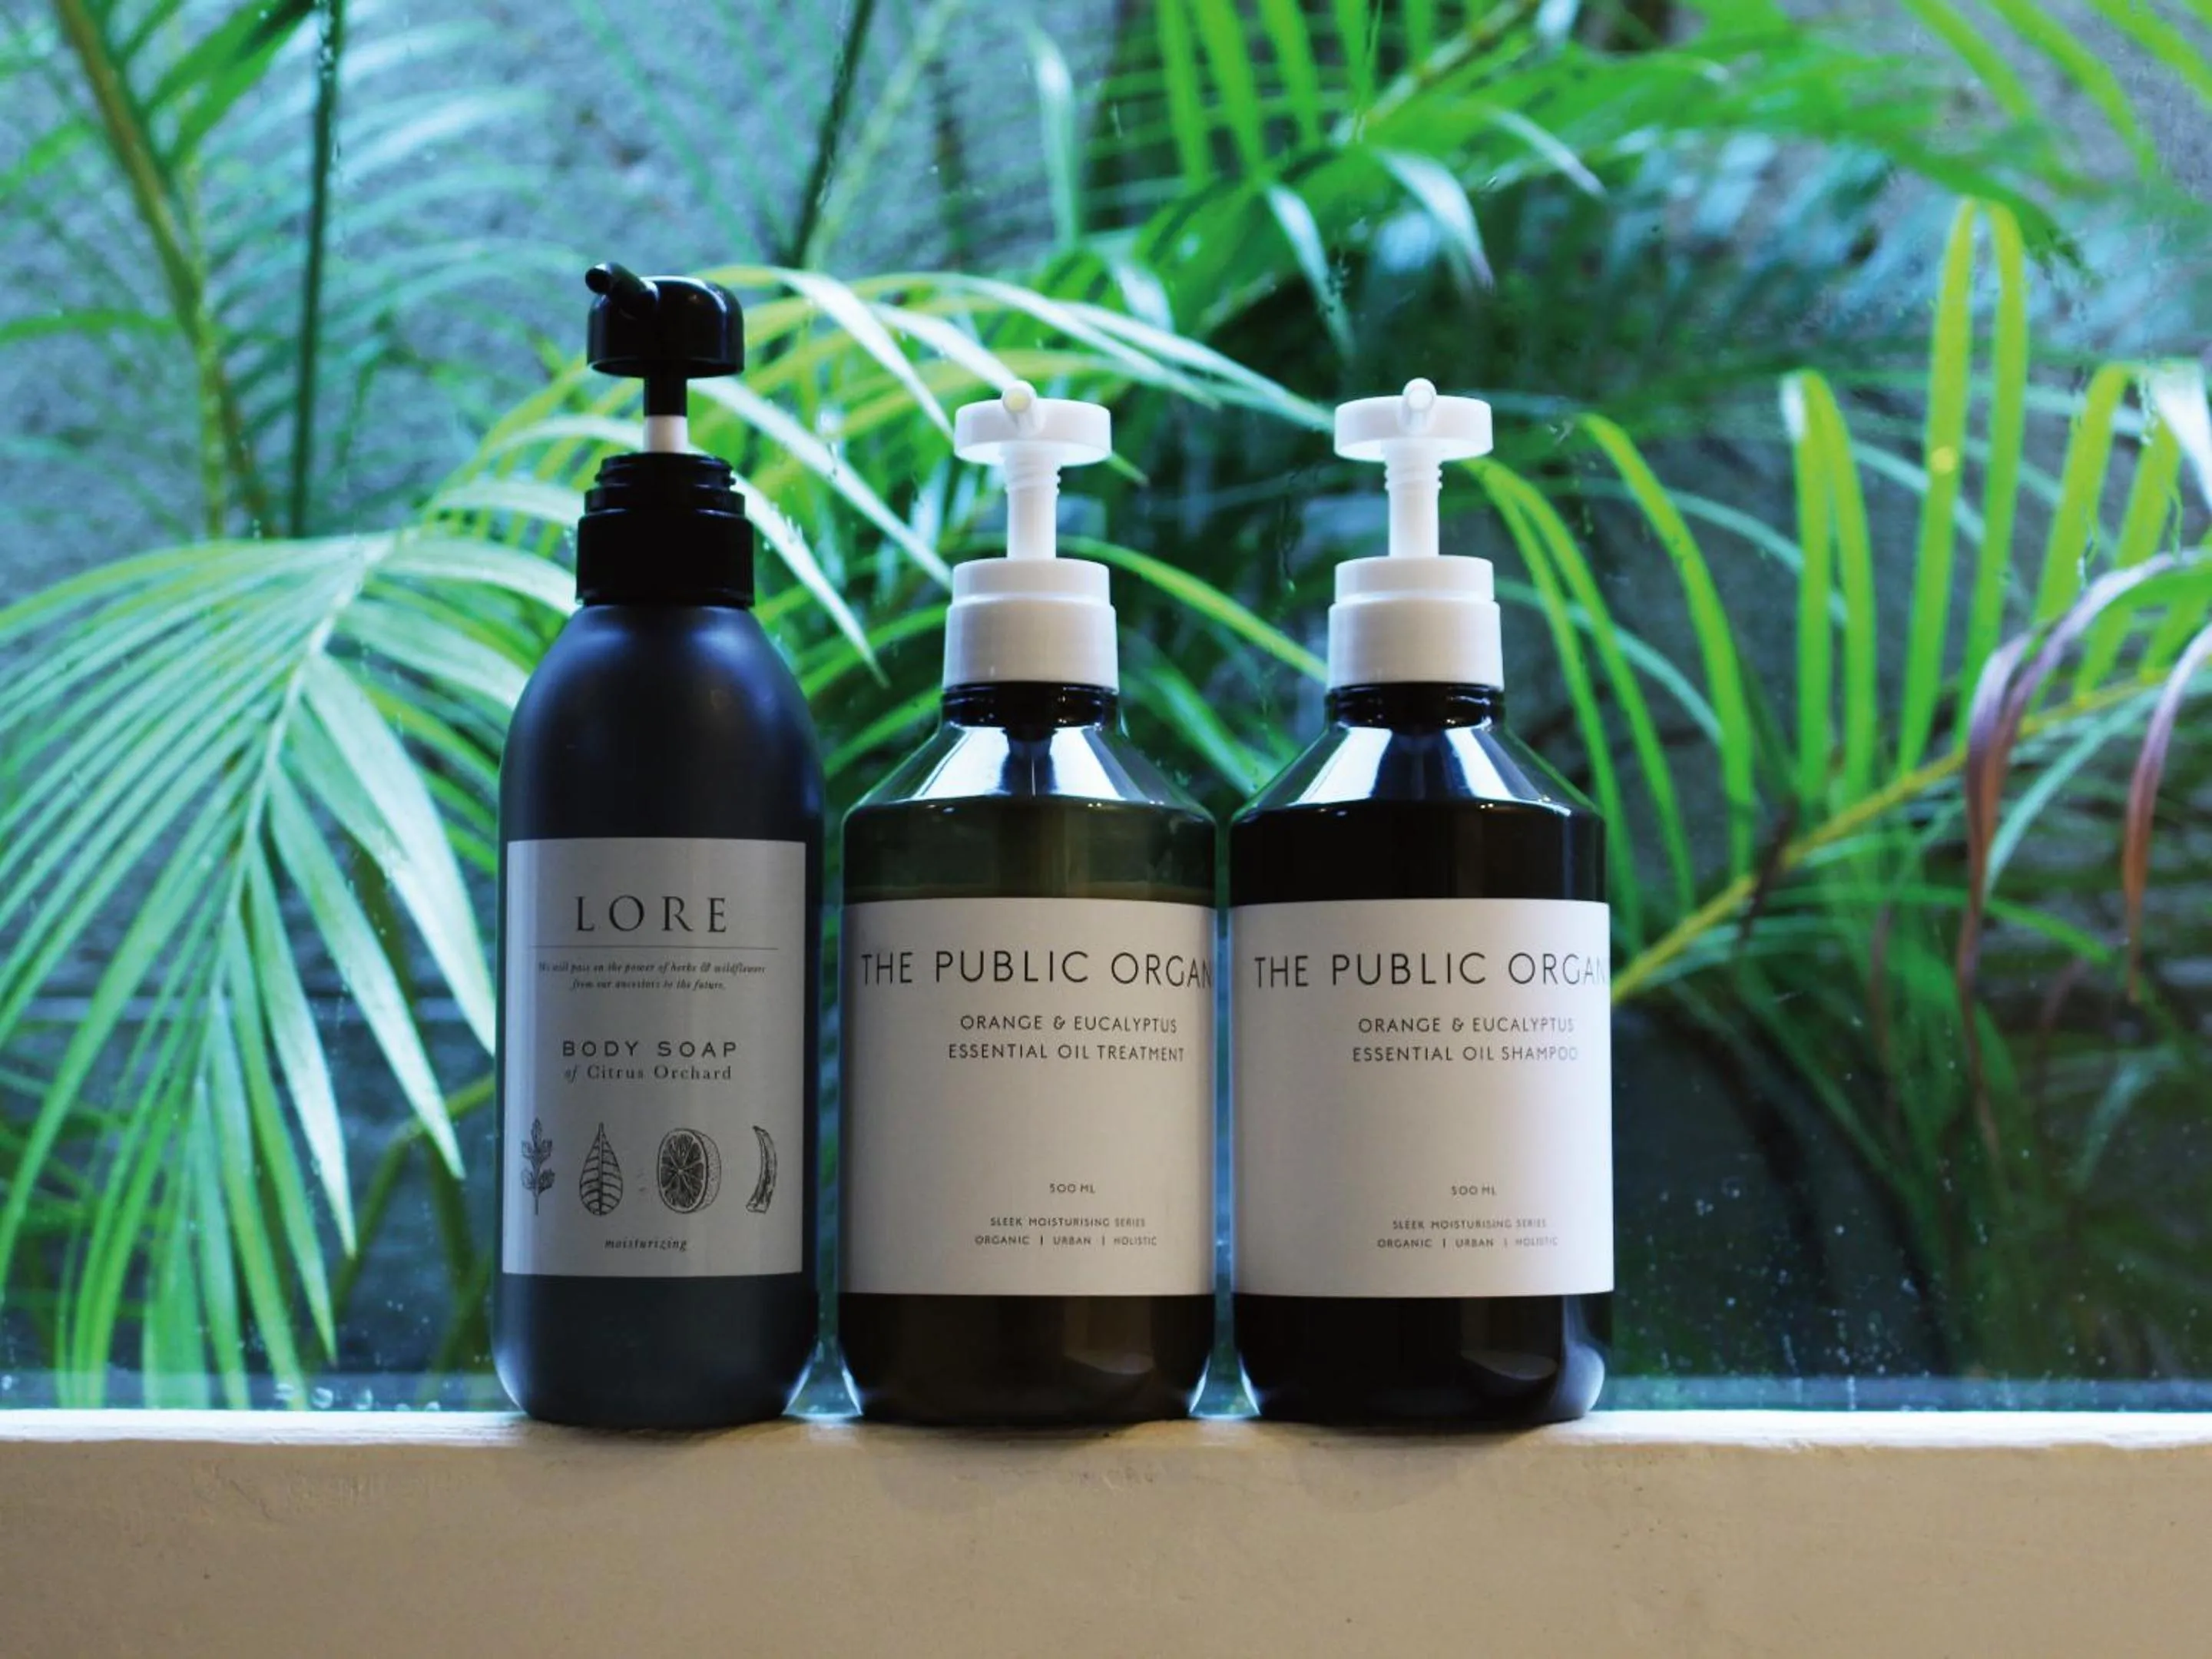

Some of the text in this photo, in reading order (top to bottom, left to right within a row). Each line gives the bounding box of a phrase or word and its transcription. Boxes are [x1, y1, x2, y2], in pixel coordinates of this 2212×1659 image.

[575, 895, 727, 933] LORE
[608, 961, 622, 972] the
[624, 963, 655, 974] power
[657, 961, 671, 975] of
[714, 962, 766, 976] wildflowers
[860, 952, 914, 985] THE
[935, 950, 1089, 984] PUBLIC
[1253, 955, 1310, 989] THE
[1332, 952, 1486, 986] PUBLIC
[568, 979, 594, 992] from
[597, 980, 612, 989] our
[615, 979, 661, 989] ancestors
[960, 1015, 1178, 1035] ORANGE & EUCALYPTUS
[1358, 1017, 1576, 1034] ORANGE & EUCALYPTUS
[562, 1041, 737, 1058] BODY SOAP
[949, 1043, 1185, 1063] ESSENTIAL OIL TREATMENT
[1352, 1045, 1578, 1062] ESSENTIAL OIL SHAMPOO
[565, 1064, 732, 1084] of Citrus Orchard
[1049, 1183, 1096, 1194] 500 ML
[1451, 1185, 1496, 1197] 500 ML
[990, 1217, 1146, 1227] SLEEK MOISTURISING SERIES
[1392, 1218, 1547, 1230] SLEEK MOISTURISING SERIES
[604, 1237, 687, 1253] moisturizing
[974, 1235, 1030, 1246] ORGANIC
[1053, 1235, 1091, 1246] URBAN
[1114, 1236, 1157, 1246] HOLISTIC
[1377, 1238, 1432, 1248] ORGANIC
[1455, 1238, 1494, 1248] URBAN
[1515, 1237, 1558, 1247] HOLISTIC
